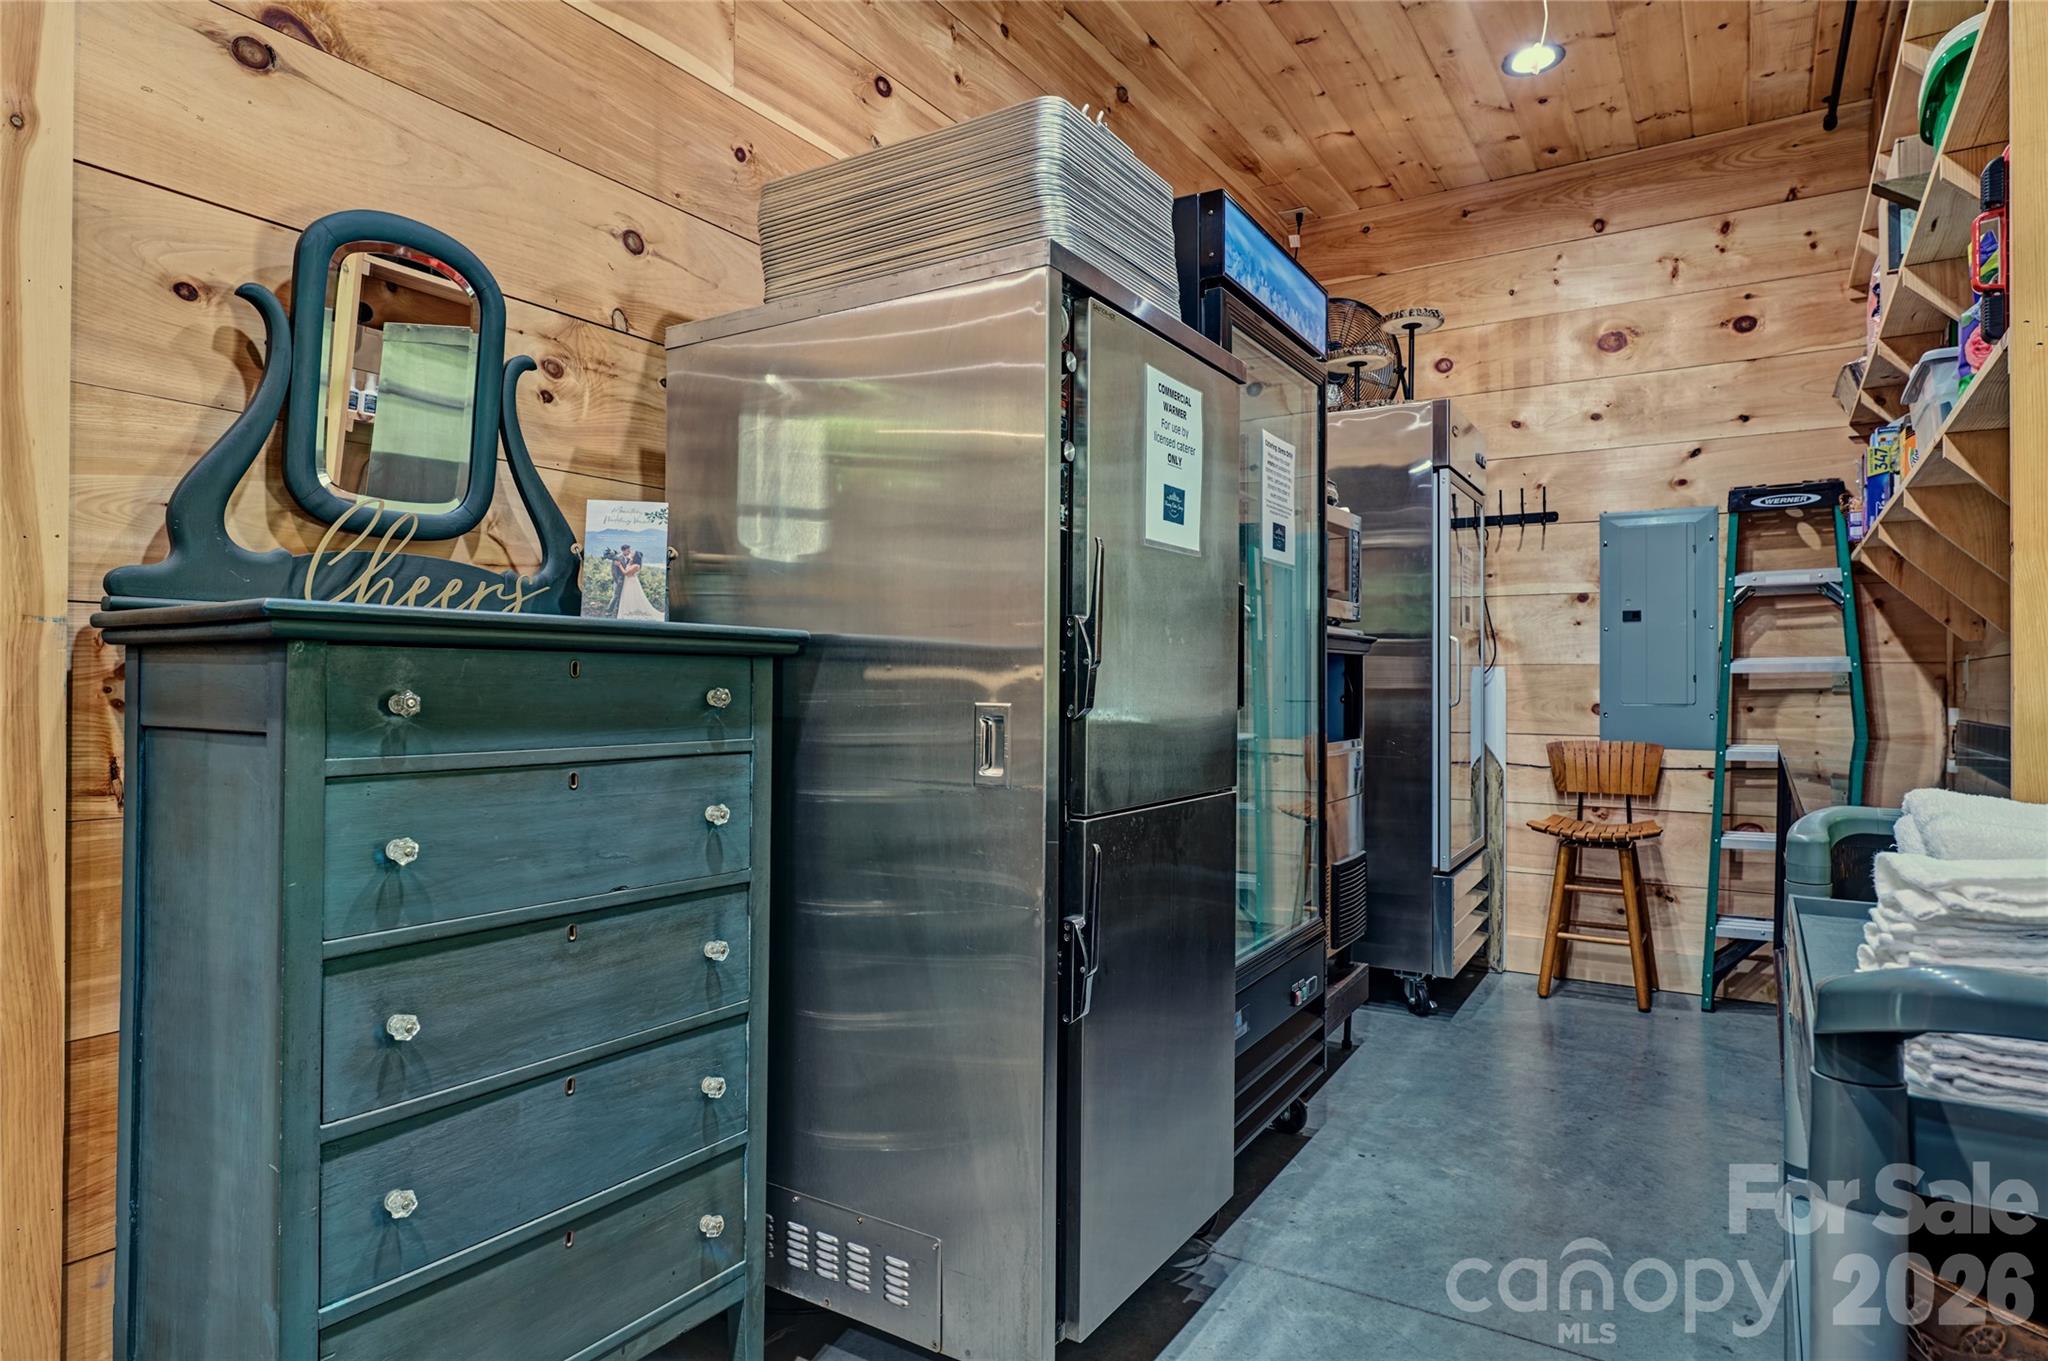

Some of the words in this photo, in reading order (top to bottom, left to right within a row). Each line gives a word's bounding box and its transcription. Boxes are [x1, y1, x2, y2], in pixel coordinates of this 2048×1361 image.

[1158, 382, 1192, 408] COMMERCIAL
[1162, 401, 1187, 420] WARMER
[1161, 418, 1171, 430] For
[1172, 424, 1181, 436] use
[1182, 426, 1189, 439] by
[1153, 431, 1176, 449] licensed
[1177, 442, 1196, 456] caterer
[1168, 453, 1183, 467] ONLY
[1874, 447, 1888, 470] 347
[1764, 496, 1808, 505] WERNER
[304, 499, 550, 613] Cheers
